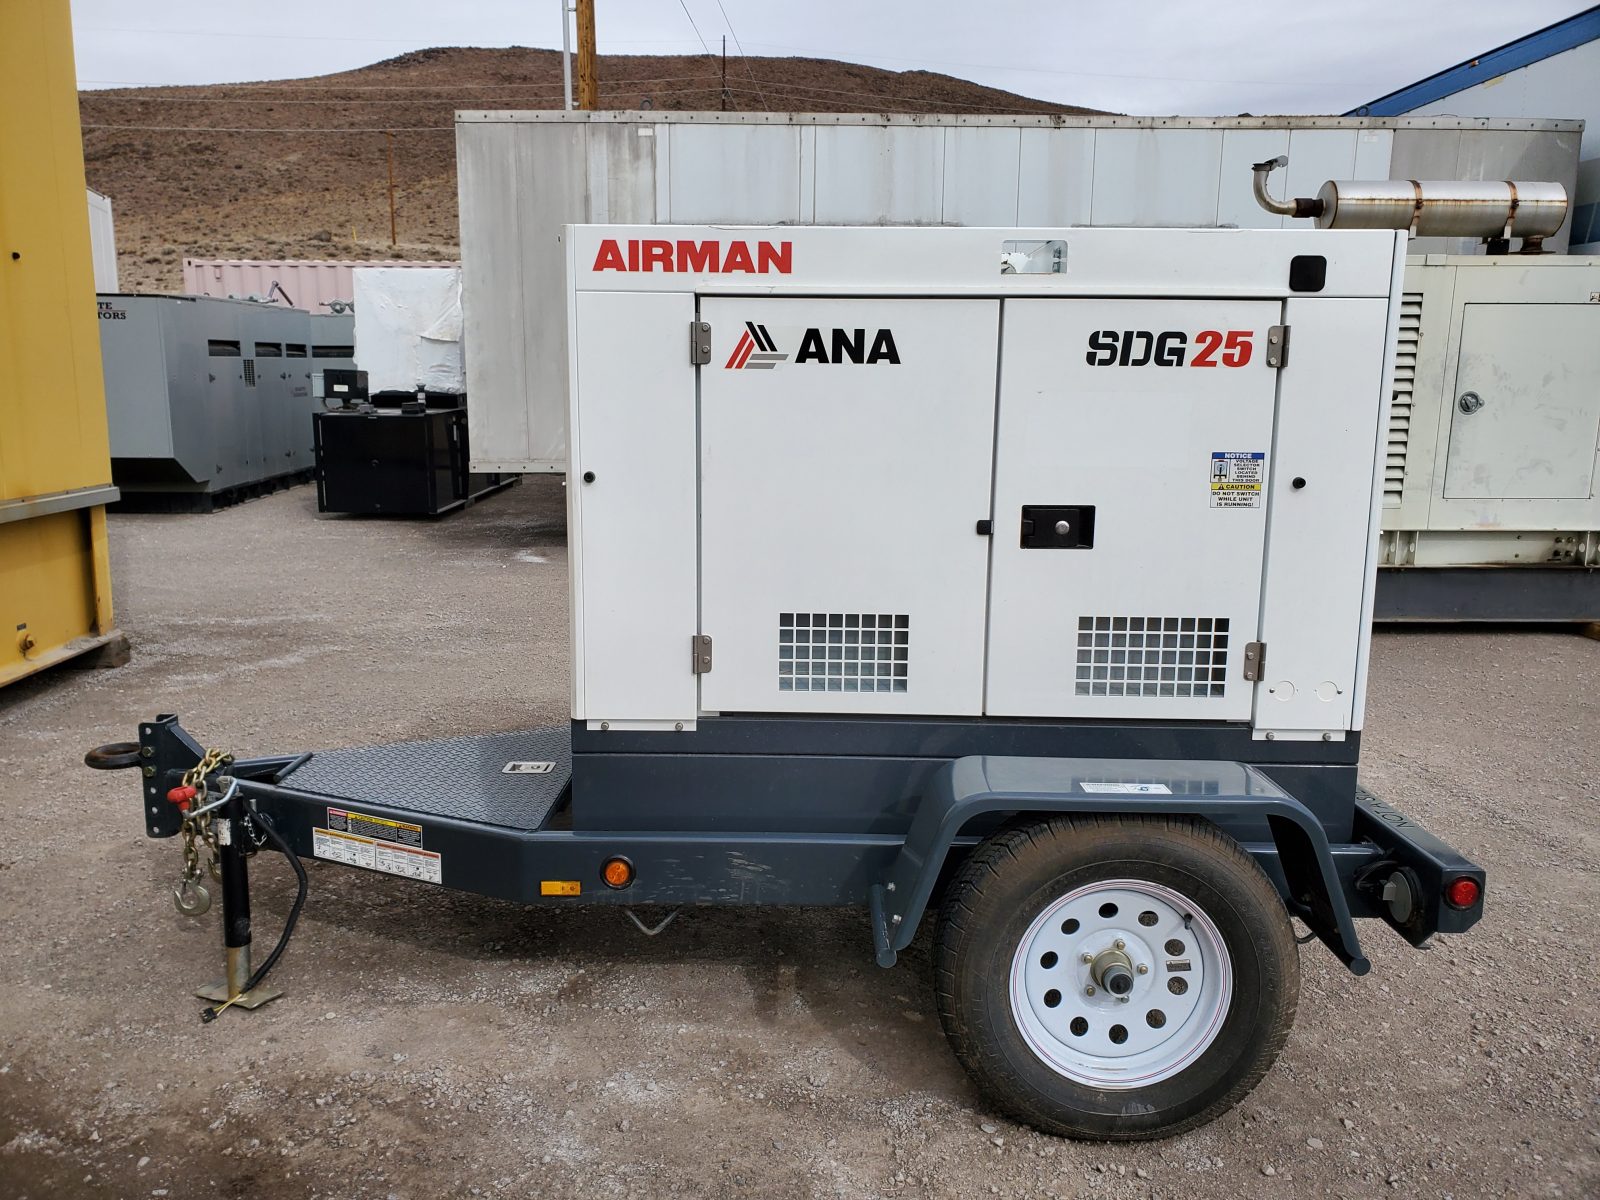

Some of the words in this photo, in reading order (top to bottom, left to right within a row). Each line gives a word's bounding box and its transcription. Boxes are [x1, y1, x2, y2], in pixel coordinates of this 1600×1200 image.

[592, 239, 793, 274] AIRMAN
[794, 328, 901, 365] ANA
[1086, 330, 1254, 368] SDG25
